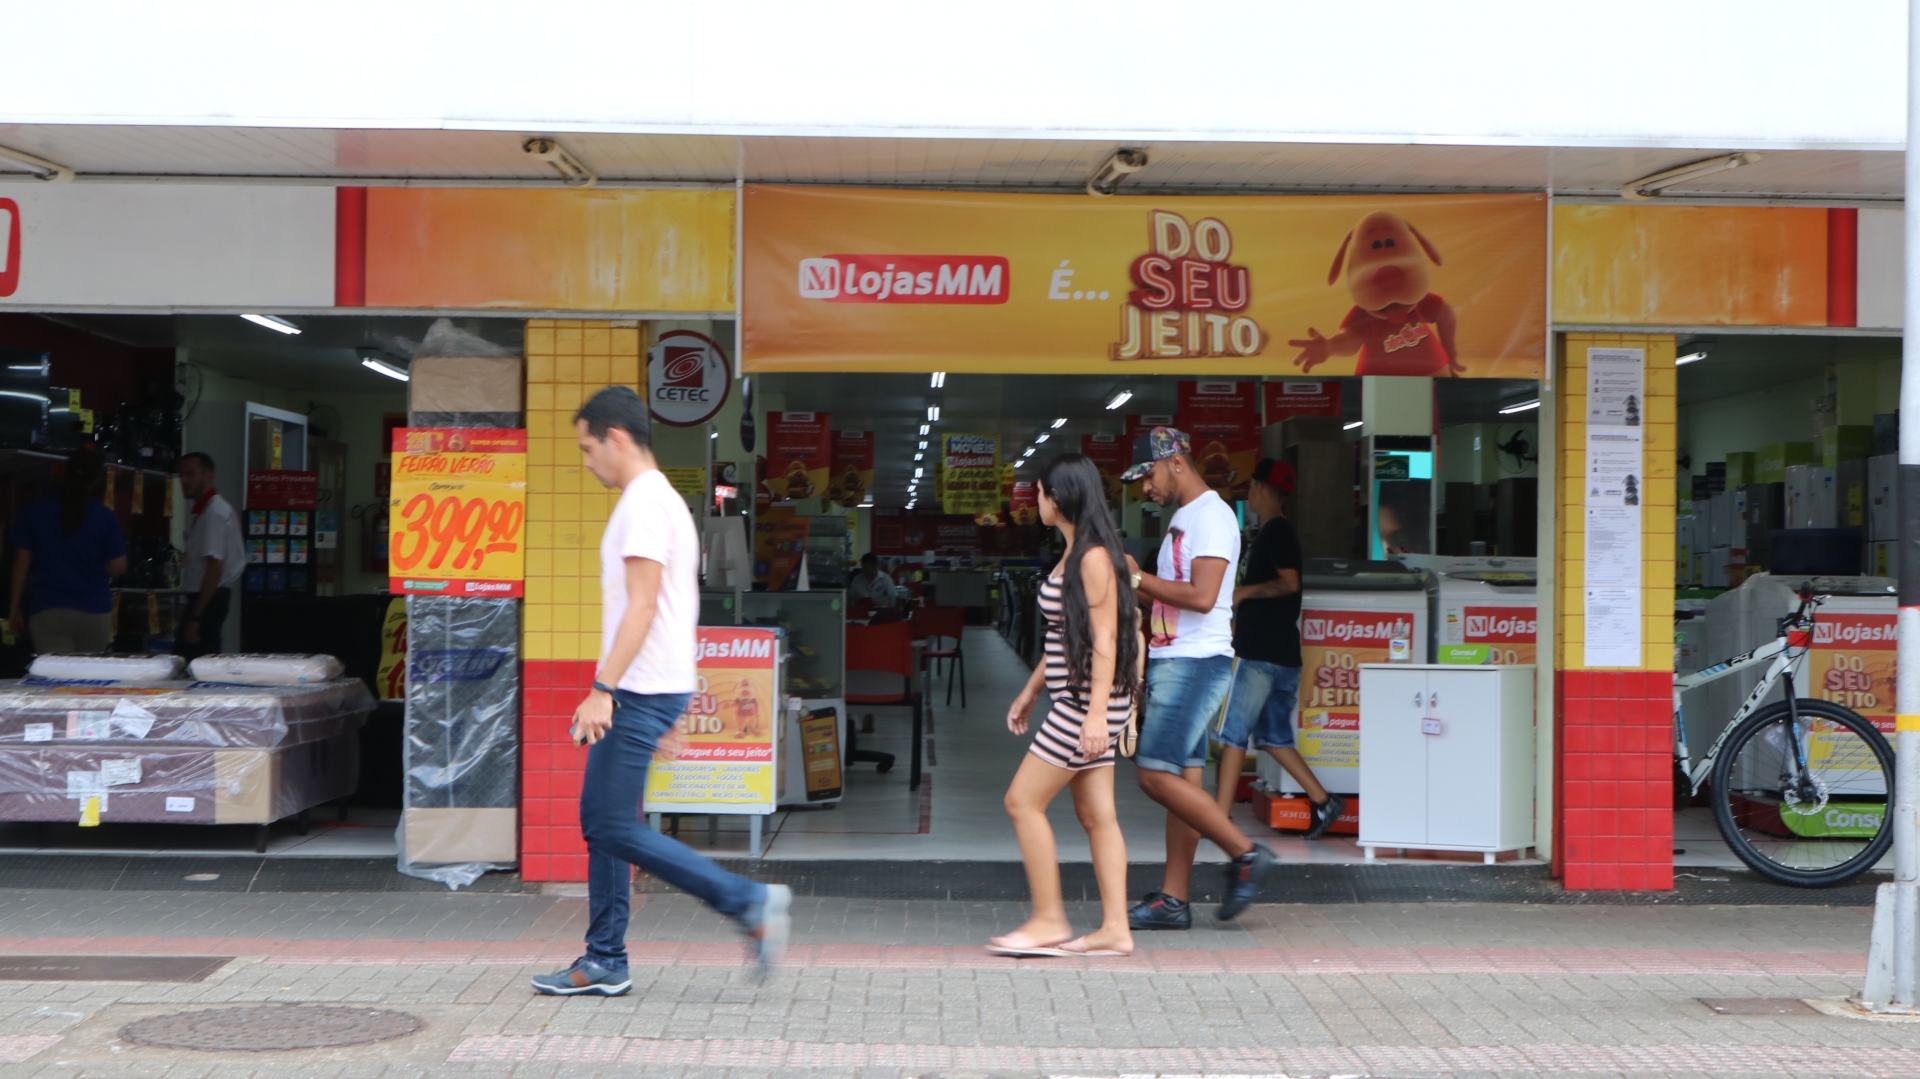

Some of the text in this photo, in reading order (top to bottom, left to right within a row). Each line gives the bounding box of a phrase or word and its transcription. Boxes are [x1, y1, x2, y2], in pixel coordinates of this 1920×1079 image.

[1151, 210, 1232, 262] DO
[1048, 259, 1110, 301] É...
[1132, 256, 1249, 310] SEU
[1117, 305, 1262, 359] JEITO
[656, 387, 709, 401] CETEC
[1325, 651, 1354, 670] DO
[1450, 649, 1477, 657] Consul
[1834, 653, 1864, 674] DO
[1827, 670, 1871, 691] SEU
[686, 695, 717, 715] EU
[681, 748, 712, 759] pague
[713, 746, 726, 757] do
[727, 748, 745, 757] seu
[1279, 810, 1298, 818] SEM
